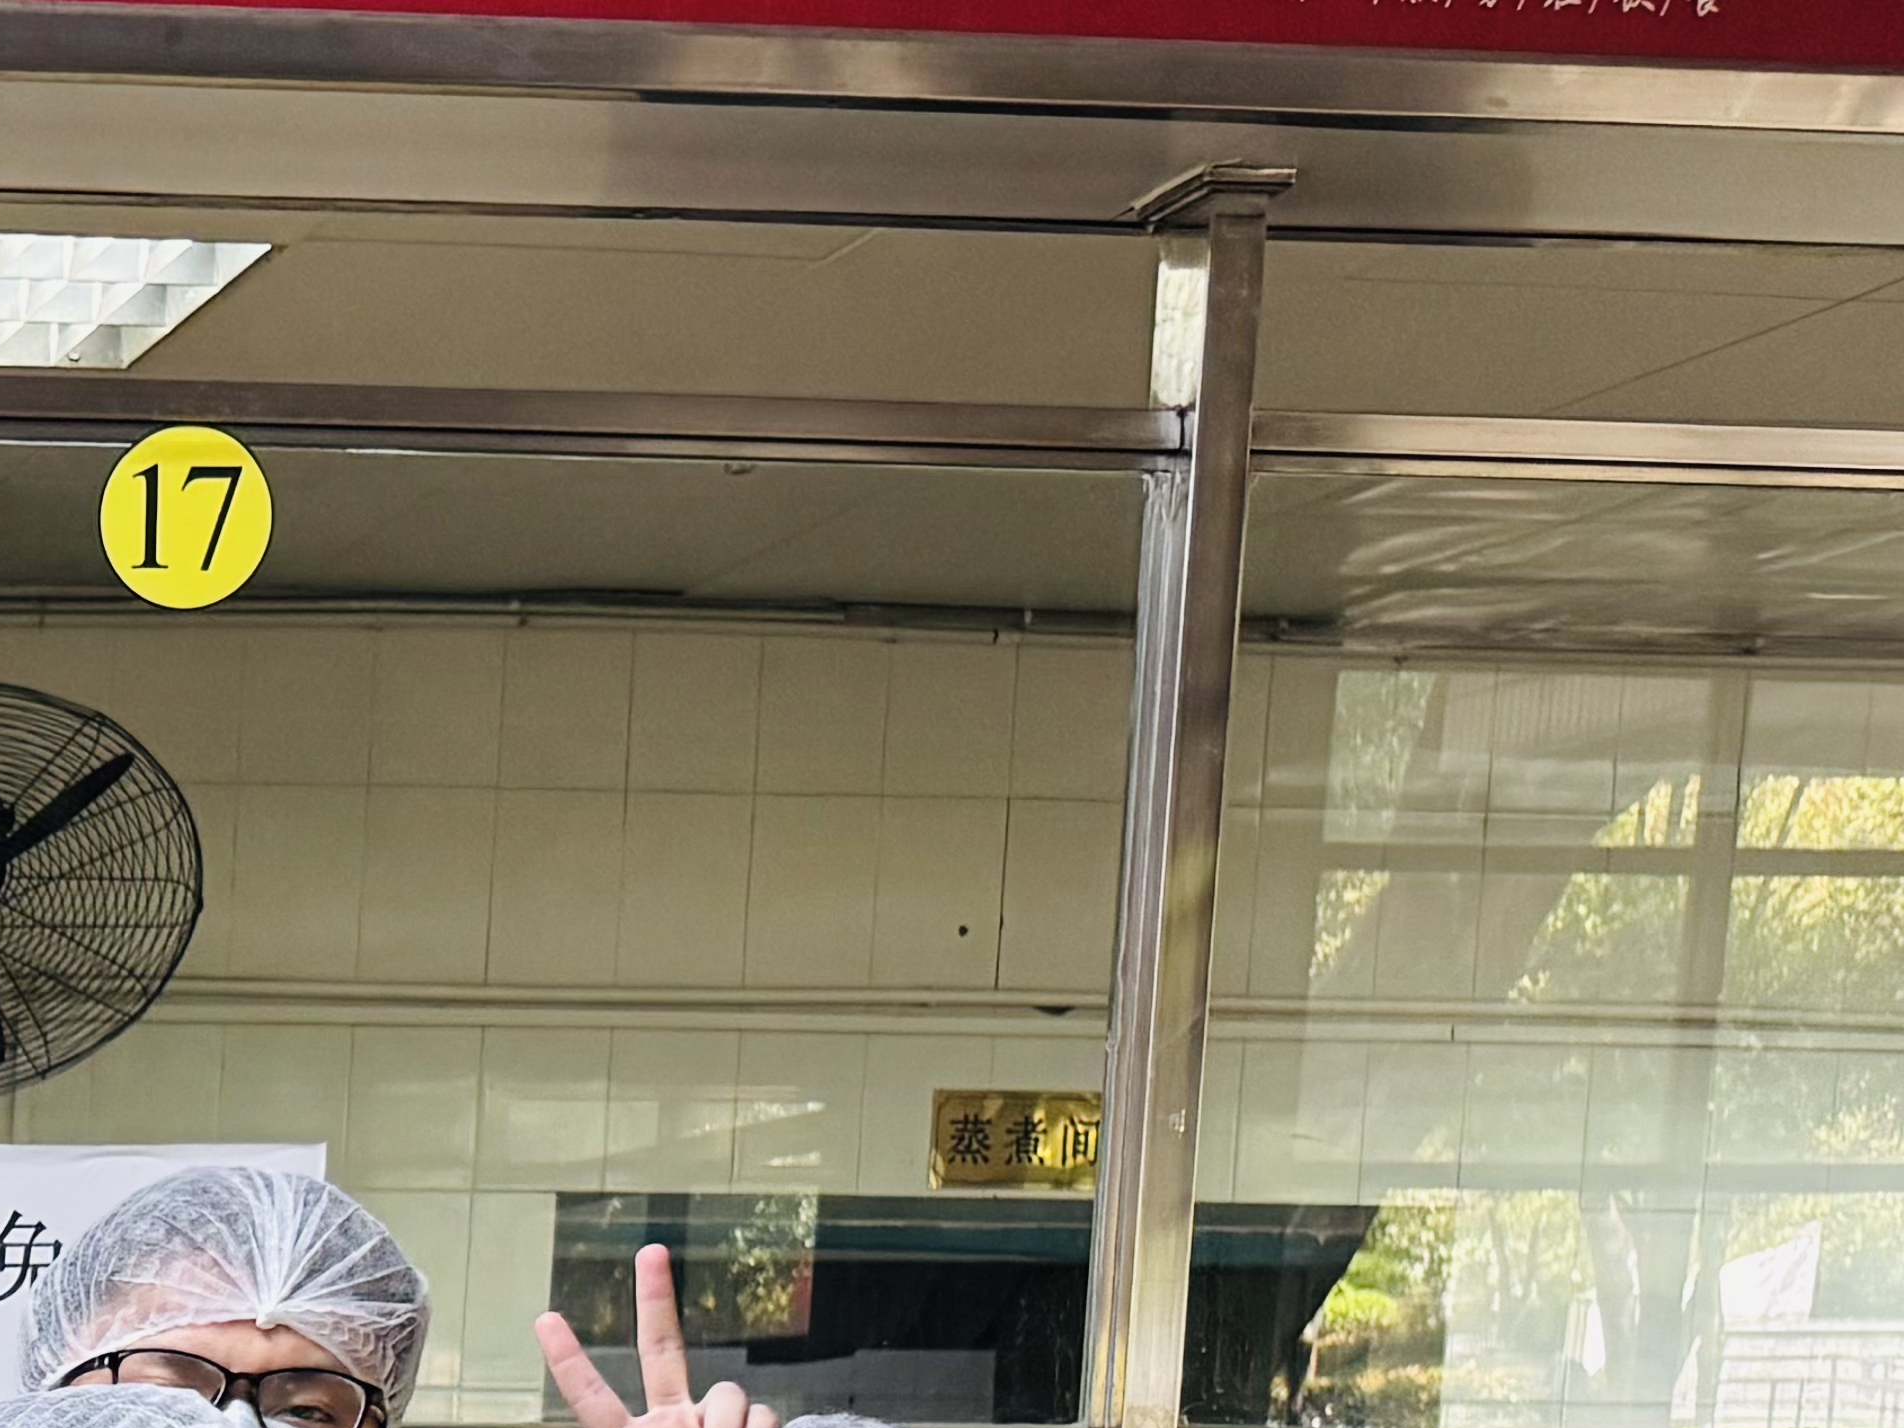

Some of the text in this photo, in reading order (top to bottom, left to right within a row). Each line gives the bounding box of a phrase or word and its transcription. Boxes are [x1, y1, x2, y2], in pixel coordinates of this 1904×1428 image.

[130, 464, 242, 573] 17
[948, 1113, 1100, 1166] 蒸煮间
